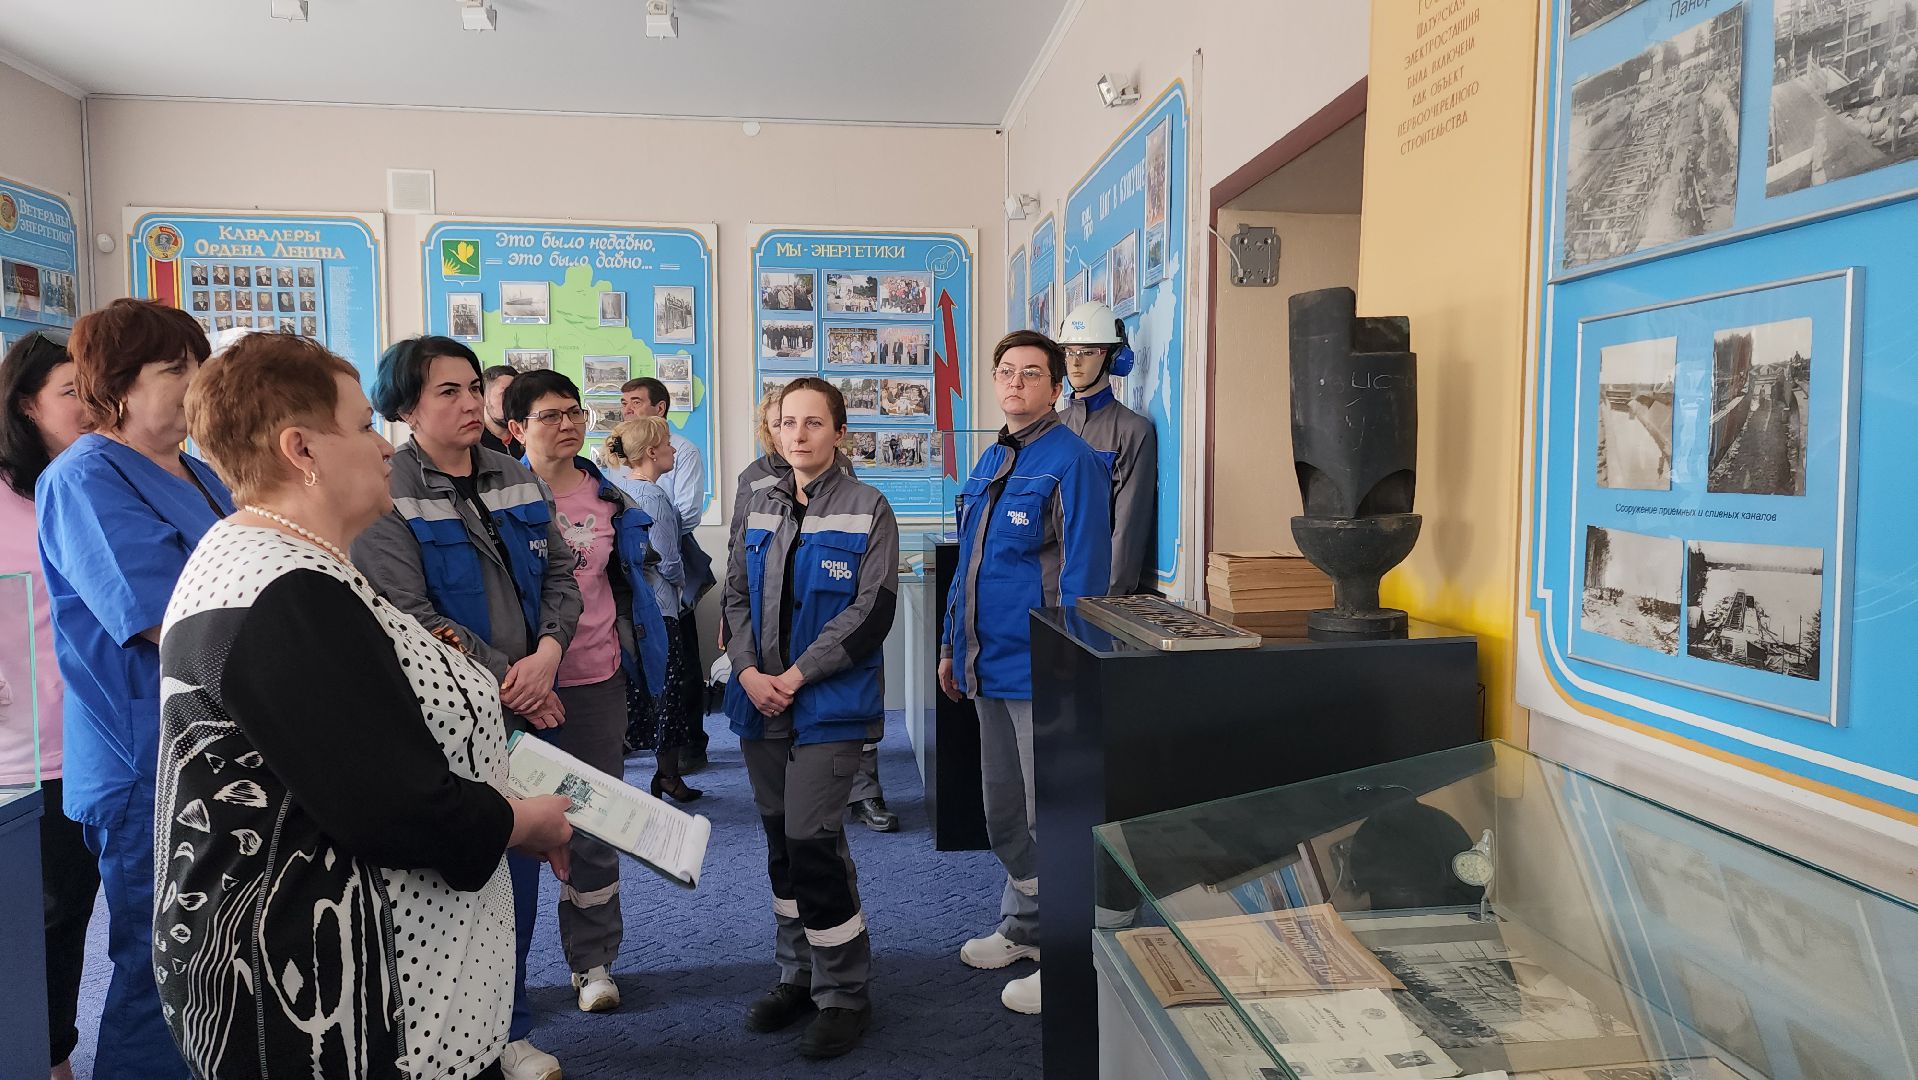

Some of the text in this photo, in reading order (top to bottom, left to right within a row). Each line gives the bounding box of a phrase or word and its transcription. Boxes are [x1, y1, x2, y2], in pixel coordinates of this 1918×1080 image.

[1404, 7, 1480, 70] ЭЛЕКТРОСТАНЦИЯ
[1407, 36, 1475, 90] БЫЛА ВКЛЮЧЕНА
[1412, 65, 1464, 108] КАК ОБЪЕКТ
[1397, 80, 1479, 137] ПЕРВООЧЕРЕДНОГО
[1400, 110, 1468, 156] СТРОИТЕЛЬСТВА
[19, 198, 69, 229] ВЕТЕРАНЫ
[218, 225, 321, 243] КАВАЛЕРЫ
[495, 231, 656, 252] Это было недавно,
[194, 239, 346, 260] ОРДЕНА ЛЕНИНА
[507, 250, 653, 270] это было давно...
[776, 242, 802, 257] МЫ
[811, 244, 906, 259] ЭНЕРГЕТИКИ
[1615, 503, 1777, 522] Сооружение приемных и сливных каналов
